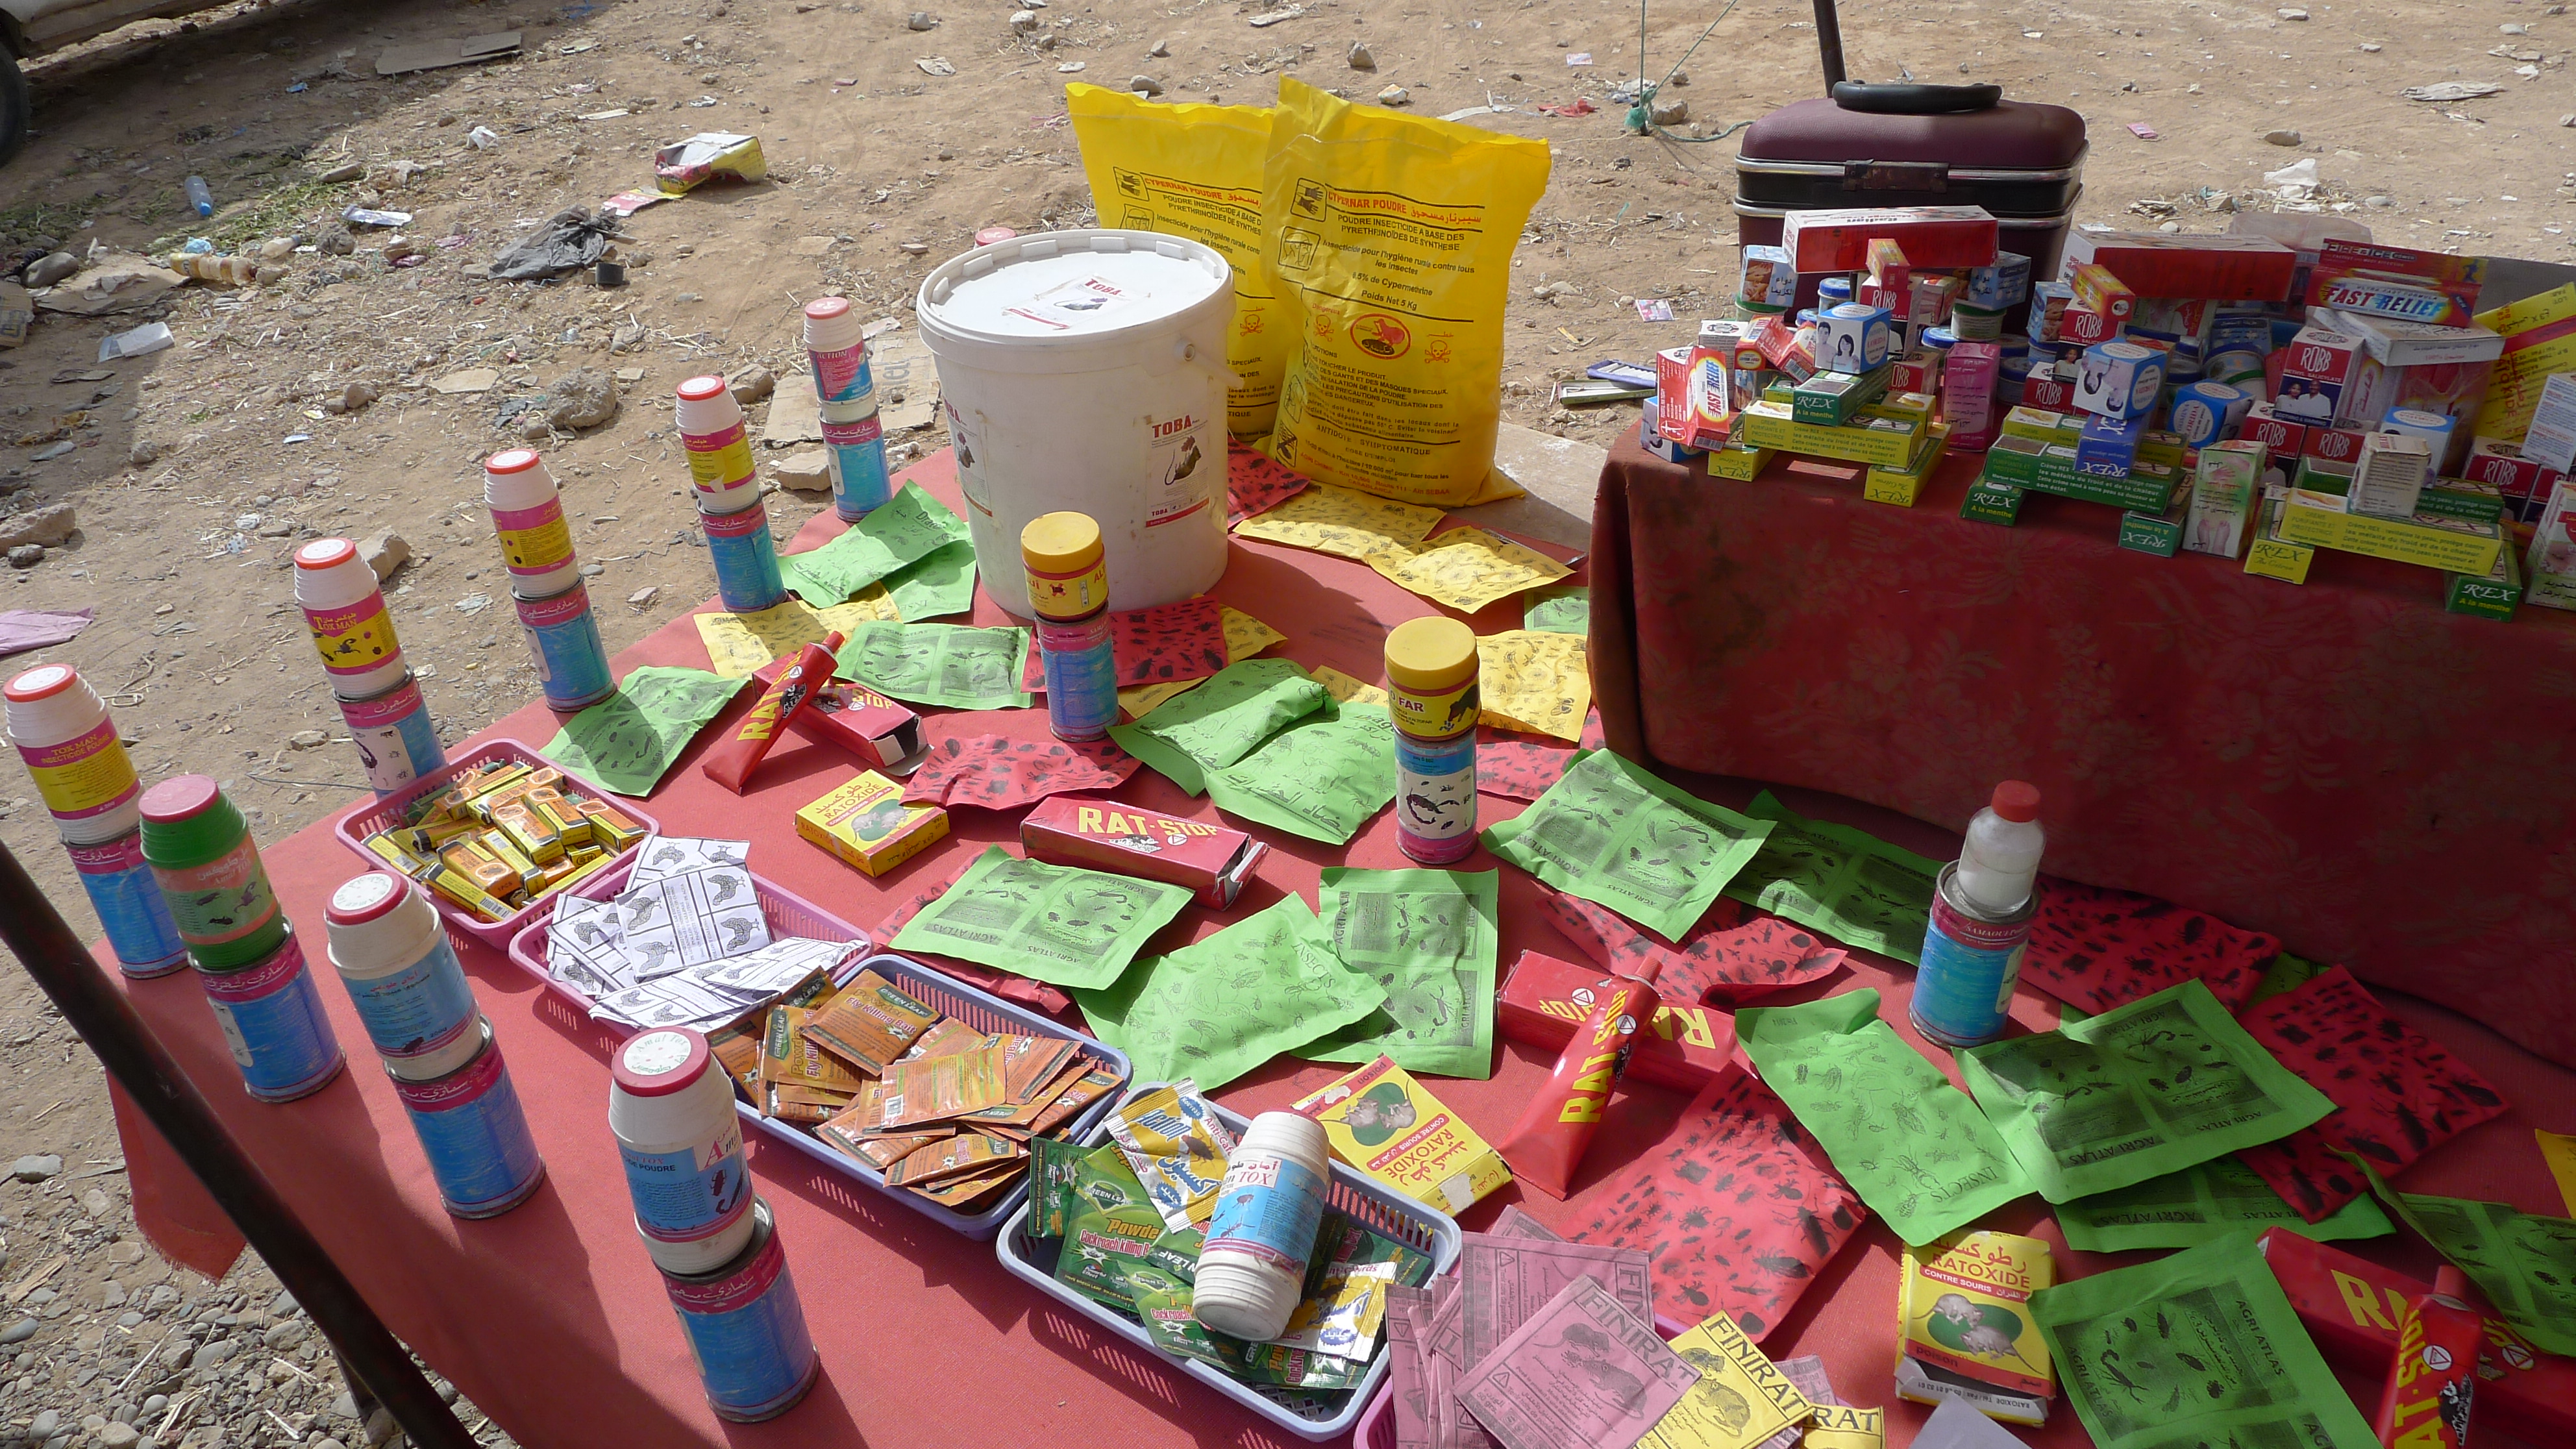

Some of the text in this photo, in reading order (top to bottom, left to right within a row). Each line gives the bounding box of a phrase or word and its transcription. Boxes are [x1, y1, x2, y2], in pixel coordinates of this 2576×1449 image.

[1189, 187, 1222, 200] POUDRE
[1163, 195, 1256, 224] POUDRE INSECTICIDE BASE
[1372, 198, 1407, 214] POUDRE
[1156, 214, 1189, 229] Insecticide
[1228, 217, 1235, 226] DE
[1338, 215, 1371, 225] POUDRE
[1373, 218, 1418, 234] INSECTICIDE
[1425, 229, 1445, 241] BASE
[1361, 247, 1380, 257] pour
[1409, 236, 1461, 251] DE SYNTHESE
[1084, 278, 1121, 296] TOBA
[1370, 276, 1380, 284] de
[1361, 290, 1417, 311] Poids Net 5 Kg
[2322, 286, 2448, 317] FAST RELIEF
[2075, 313, 2103, 338] ROBB
[816, 349, 848, 360] ACTION
[2300, 345, 2332, 373] ROBB
[1380, 381, 1412, 393] MASQUES
[2035, 381, 2062, 405] ROBB
[1796, 395, 1835, 409] REX
[1152, 414, 1193, 438] TOBA
[1809, 411, 1834, 419] menthe
[2256, 422, 2286, 447] ROBB
[2318, 432, 2351, 457] ROBB
[1714, 465, 1752, 478] REX
[2080, 461, 2128, 478] REX
[2483, 459, 2518, 486] ROBB
[1870, 488, 1911, 504] REX
[1972, 491, 2015, 508] REX
[1986, 508, 2012, 519] menthe
[2122, 531, 2168, 549] REX
[2253, 541, 2305, 563] REX
[2461, 584, 2517, 602] REX
[2467, 598, 2511, 612] la menthe
[312, 615, 358, 631] TOX MAN
[737, 685, 783, 741] RAT
[1398, 696, 1424, 713] FAR
[41, 748, 86, 764] INSECTICIDE
[51, 734, 97, 756] TOX MAN
[823, 783, 882, 819] RATOXIDE
[1077, 806, 1218, 837] RAT STOP
[1516, 833, 1582, 876] AGRI ATLAS
[932, 923, 998, 943] AGRI ATLAS
[1291, 942, 1336, 989] INSECTS
[854, 988, 907, 1019] Powder
[880, 986, 928, 1017] GREEN LEAF
[845, 997, 917, 1035] Fly Killing Bait
[636, 1034, 667, 1052] Amal
[1557, 989, 1628, 1123] RAT STOP
[1131, 1109, 1192, 1143] Action
[1399, 1117, 1444, 1151] CONTRE SOURIS
[1384, 1128, 1455, 1179] RATOXIDE
[2068, 1136, 2156, 1165] AGRI ATLAS
[639, 1164, 676, 1172] POUDRE
[1238, 1170, 1273, 1185] TOX
[1929, 1165, 2000, 1204] INSECTS
[1080, 1229, 1119, 1252] Cockroach
[1924, 1268, 1992, 1293] CONTRE SOURIS
[1932, 1252, 2031, 1289] RATOXIDE
[1579, 1291, 1698, 1381] FINIRAT
[2235, 1297, 2285, 1378] AGRI ATLAS
[1705, 1315, 1809, 1413] FINIRAT
[1916, 1346, 1958, 1368] poison
